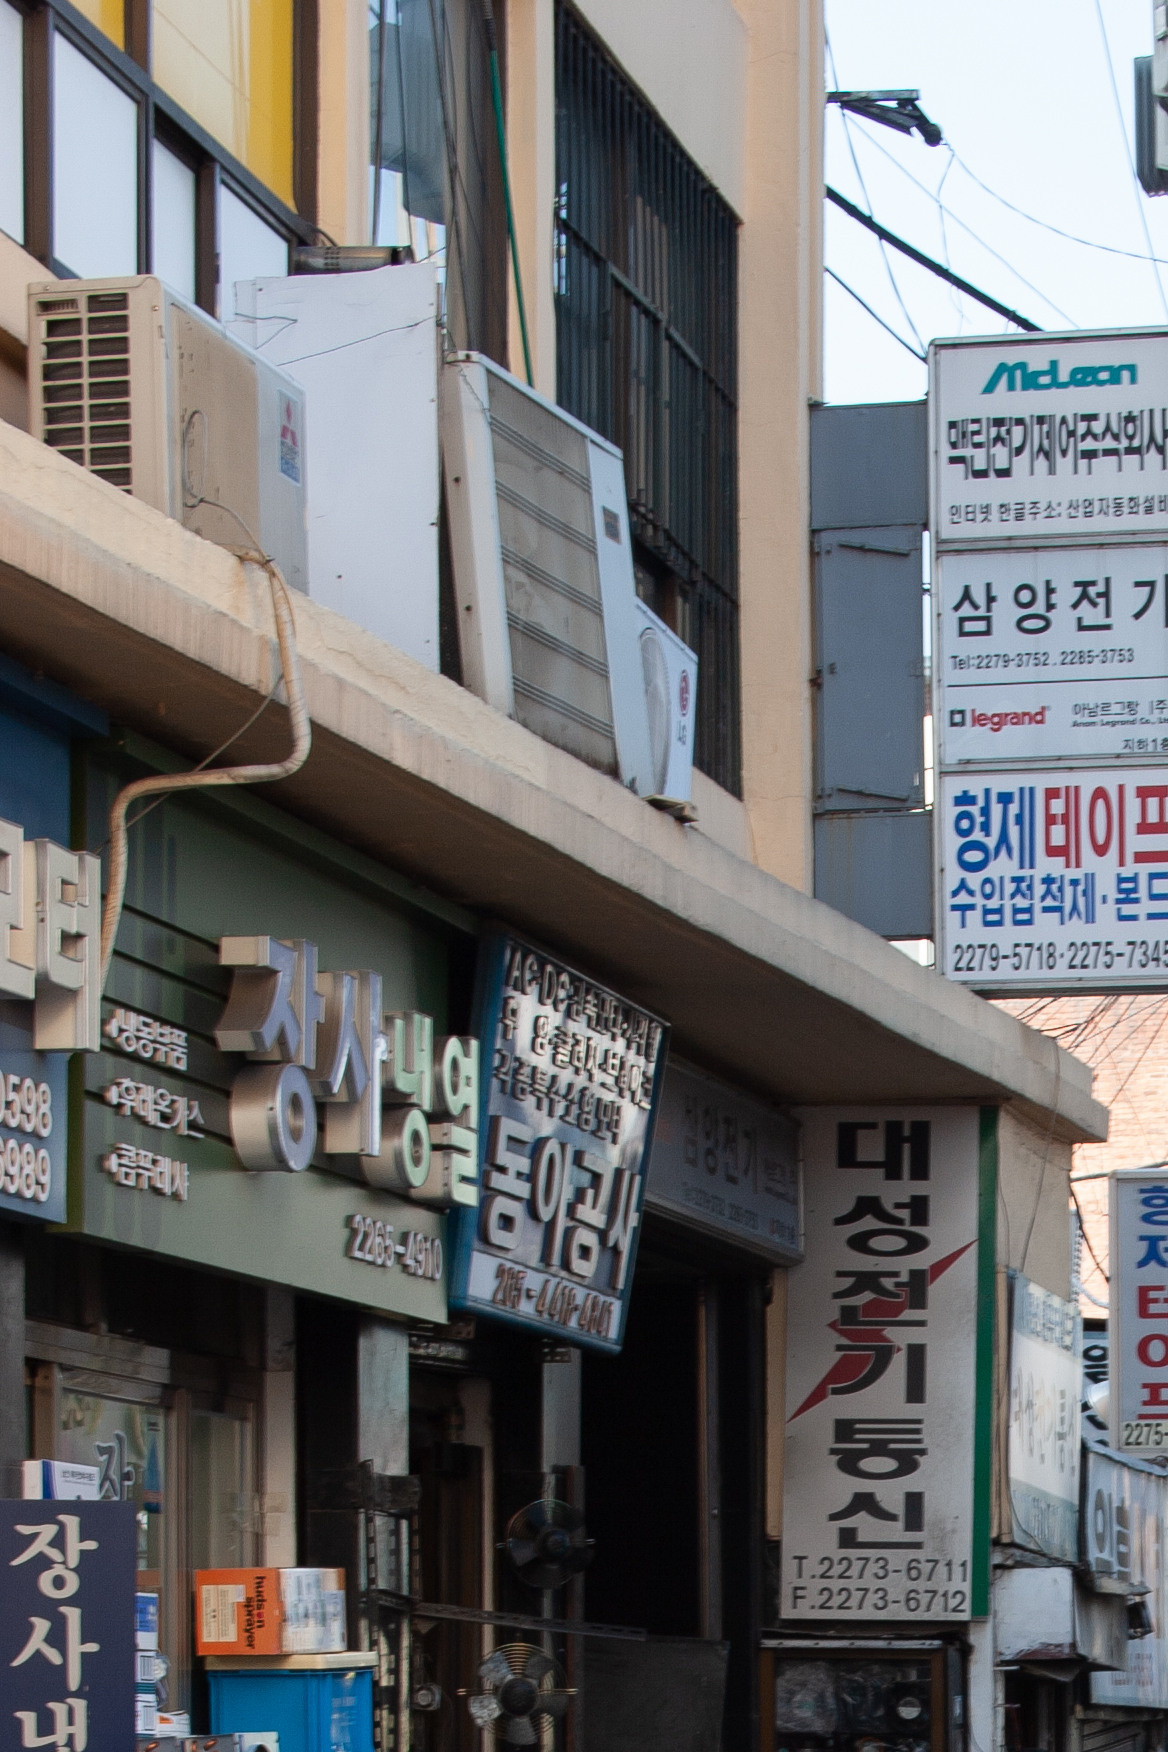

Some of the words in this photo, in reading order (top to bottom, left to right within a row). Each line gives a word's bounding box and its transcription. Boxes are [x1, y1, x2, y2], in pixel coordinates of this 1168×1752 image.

[980, 360, 1138, 394] McLean
[950, 503, 992, 524] 인터넷
[972, 705, 1047, 732] legrand
[0, 1068, 52, 1138] 598
[482, 1114, 642, 1290] 동아공사
[346, 1212, 443, 1280] 2265-4910
[828, 1120, 931, 1549] 대성전기통신
[793, 1556, 968, 1582] T.2273-6711
[244, 1596, 255, 1649] sprayer
[255, 1576, 266, 1629] hudson
[791, 1587, 968, 1613] F.2273-6712
